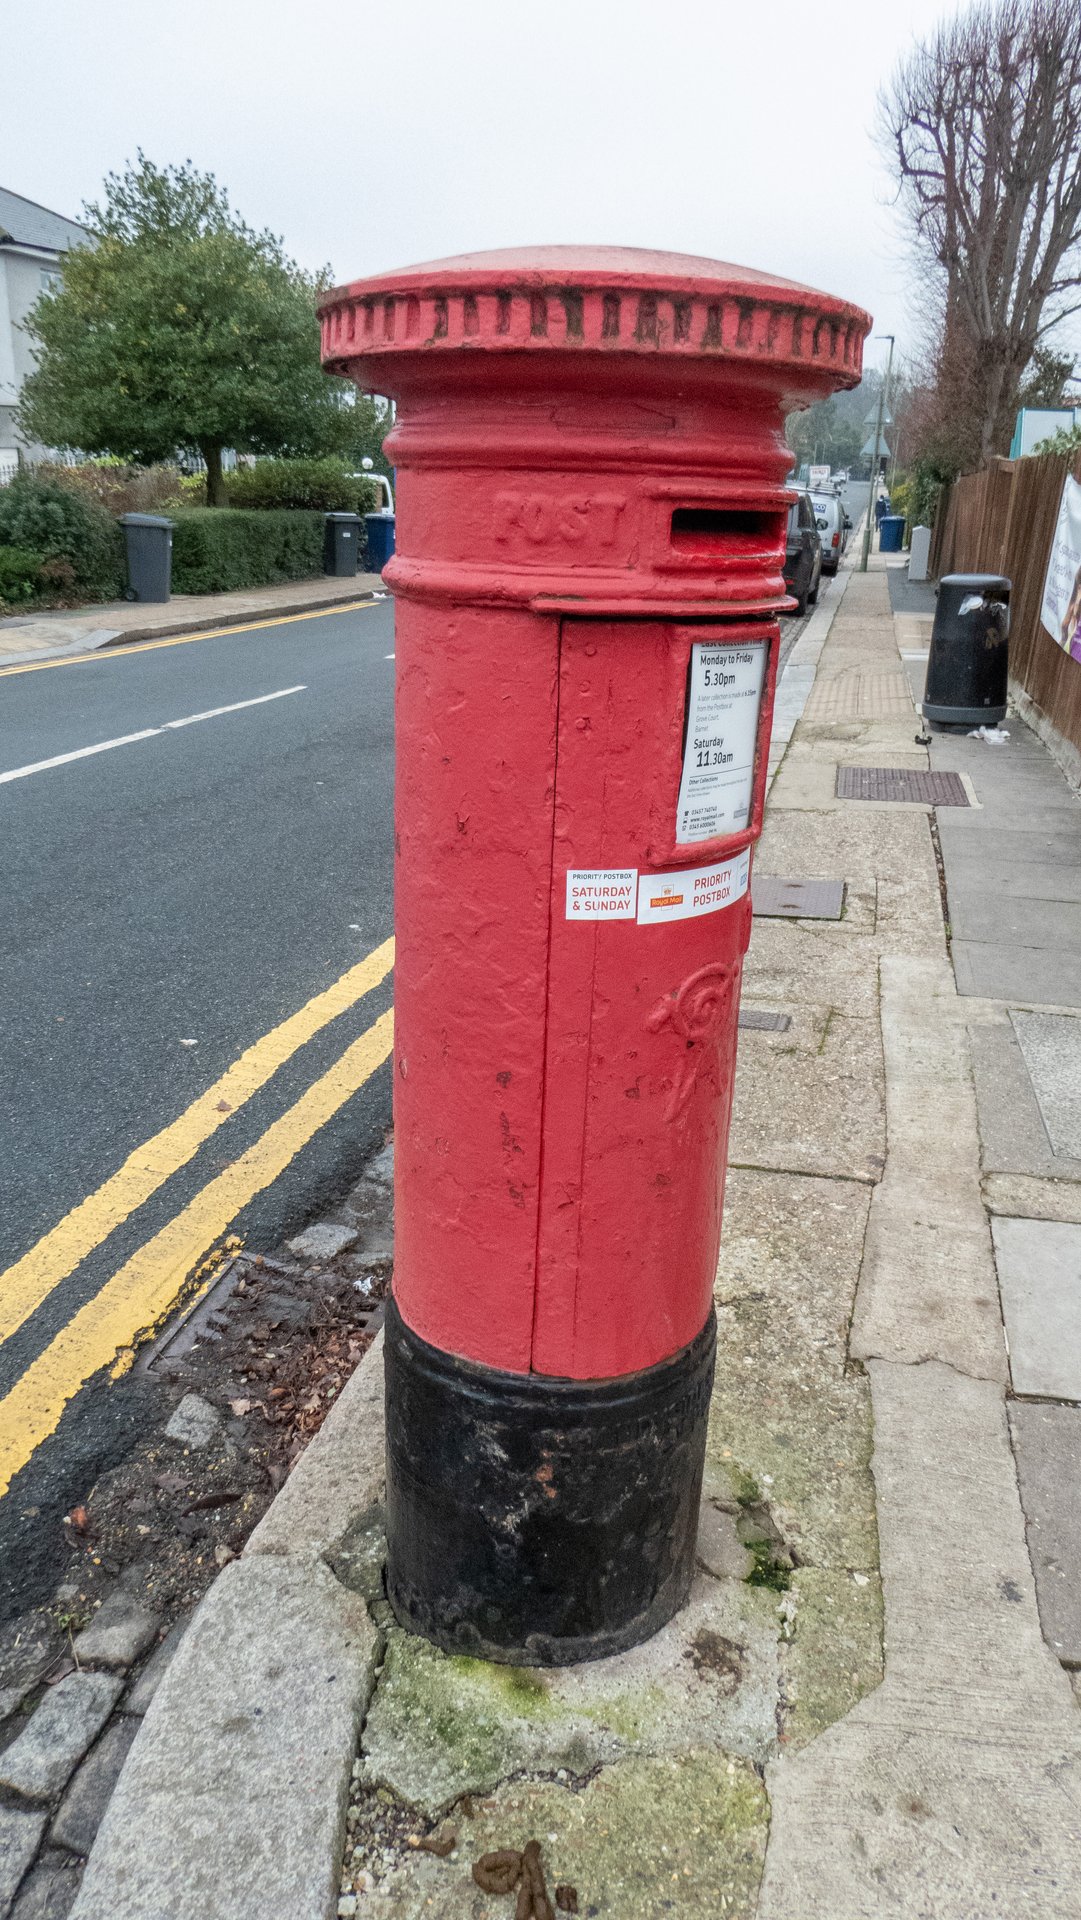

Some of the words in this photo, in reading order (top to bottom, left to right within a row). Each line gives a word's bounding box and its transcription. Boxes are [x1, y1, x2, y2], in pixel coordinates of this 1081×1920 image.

[700, 654, 728, 667] Monday
[728, 654, 735, 664] to
[736, 652, 754, 664] Friday
[704, 669, 736, 687] 5.30pm
[693, 737, 724, 750] Saturday
[696, 750, 733, 767] 11.30am
[694, 869, 732, 890] PRIORITY
[572, 886, 632, 897] SATURDAY
[693, 886, 731, 907] POSTBOX
[572, 901, 580, 911] &
[584, 900, 631, 911] SUNDAY
[651, 897, 669, 906] Royal
[669, 896, 683, 904] Mail
